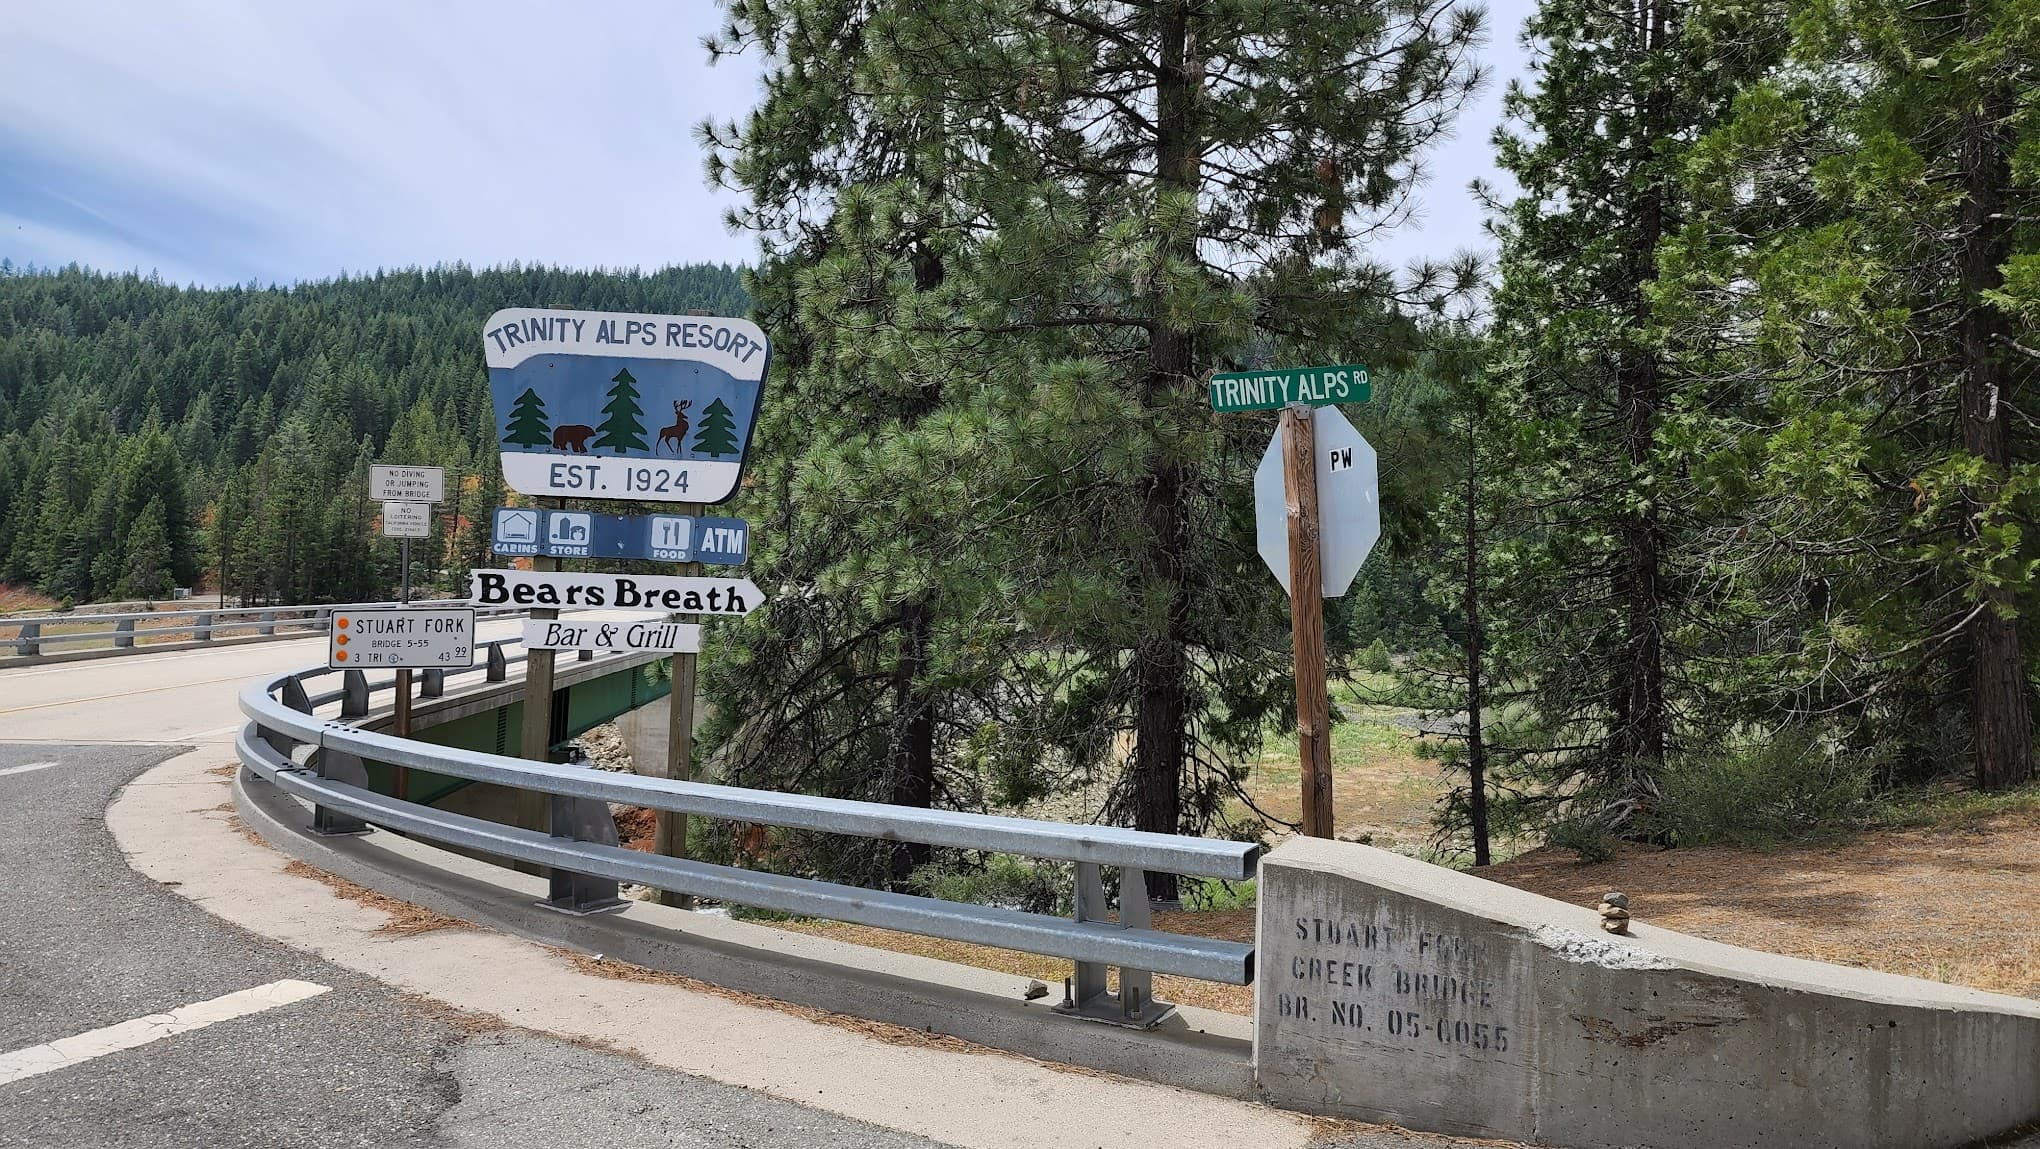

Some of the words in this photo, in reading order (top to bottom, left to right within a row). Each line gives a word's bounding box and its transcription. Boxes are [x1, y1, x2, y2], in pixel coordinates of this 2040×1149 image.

[487, 317, 585, 353] TRINITY
[596, 319, 657, 346] ALPS
[665, 322, 763, 363] RESORT
[1212, 375, 1290, 407] TRINITY
[1298, 370, 1349, 401] ALPS
[1353, 370, 1368, 385] RD
[1330, 447, 1352, 471] PW
[385, 479, 395, 487] OR
[397, 480, 429, 488] JUMPING
[401, 470, 425, 478] DIVING
[550, 463, 607, 491] EST.
[626, 467, 689, 494] 1924
[383, 489, 402, 497] FROM
[405, 490, 431, 498] BRIDGE
[493, 543, 538, 554] CABINS
[550, 545, 588, 556] STORE
[701, 527, 744, 555] ATM
[653, 549, 686, 560] FOOD
[477, 573, 605, 606] Bears
[613, 578, 748, 613] Breath
[356, 619, 415, 634] STUART
[425, 618, 464, 633] FORK
[544, 623, 588, 647] Bar
[595, 623, 619, 648] &
[626, 623, 678, 649] Grill
[354, 653, 360, 663] 3
[368, 653, 382, 663] TRI
[438, 652, 451, 662] 43
[455, 646, 467, 656] 99
[371, 640, 402, 648] BRIDGE
[407, 640, 429, 648] 5-55
[1296, 917, 1393, 950] STUART
[1292, 956, 1373, 989] CREEK
[1396, 969, 1493, 1008] BRIDGE
[1278, 993, 1317, 1022] BR.
[1332, 1000, 1372, 1032] NO.
[1387, 1009, 1509, 1053] 05-0055
